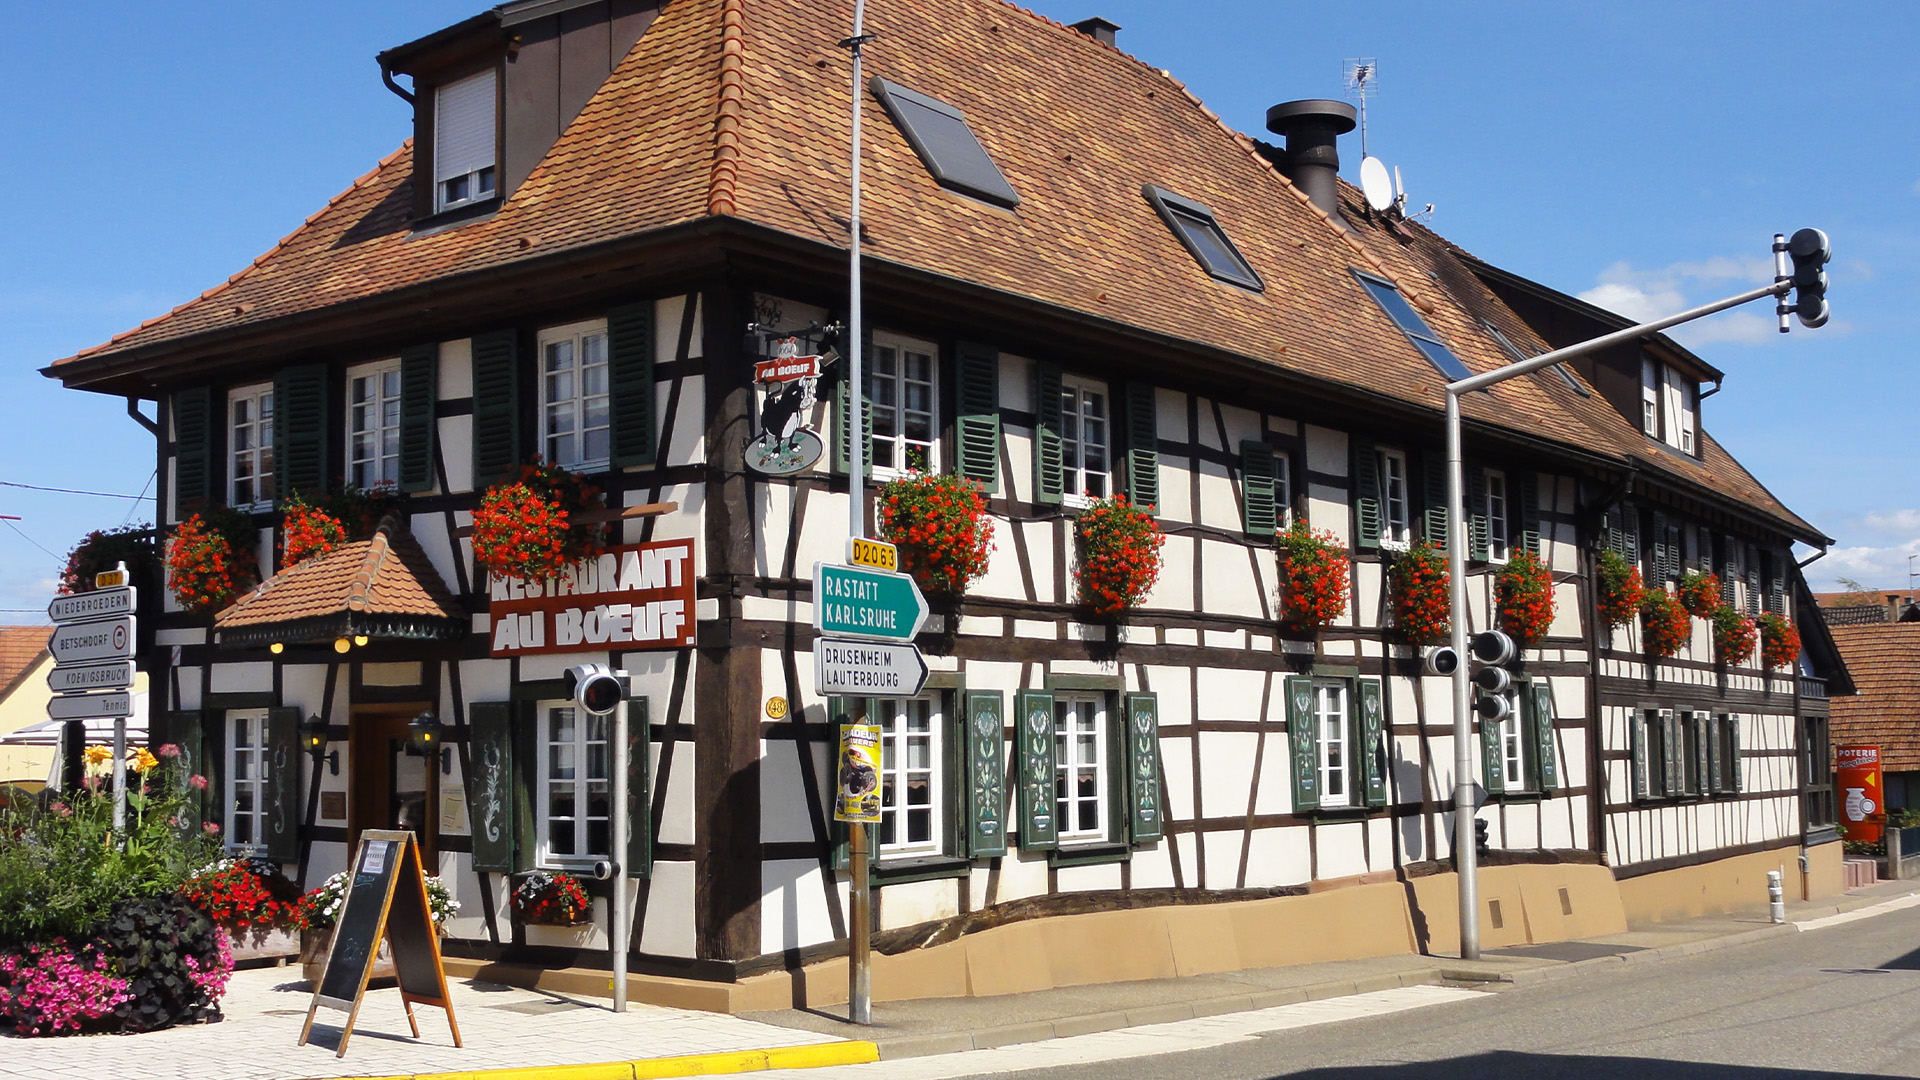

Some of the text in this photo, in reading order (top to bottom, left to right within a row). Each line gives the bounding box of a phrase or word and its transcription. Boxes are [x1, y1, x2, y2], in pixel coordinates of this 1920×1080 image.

[761, 367, 775, 378] AU
[853, 542, 895, 567] D2063
[101, 574, 119, 586] D 37
[826, 575, 879, 601] RASTATT
[56, 595, 128, 615] NIEDERROEDERN
[826, 602, 897, 630] KARLSRUHE
[493, 610, 545, 651] AU
[60, 633, 108, 650] BETSCHDORF
[826, 647, 892, 667] DRUSENHEIM
[66, 668, 128, 684] KOENIGSBRUCK
[826, 669, 899, 688] LAUTERBOURG
[102, 698, 127, 711] Tennis
[772, 701, 783, 713] 48
[1838, 749, 1877, 757] POTERIE
